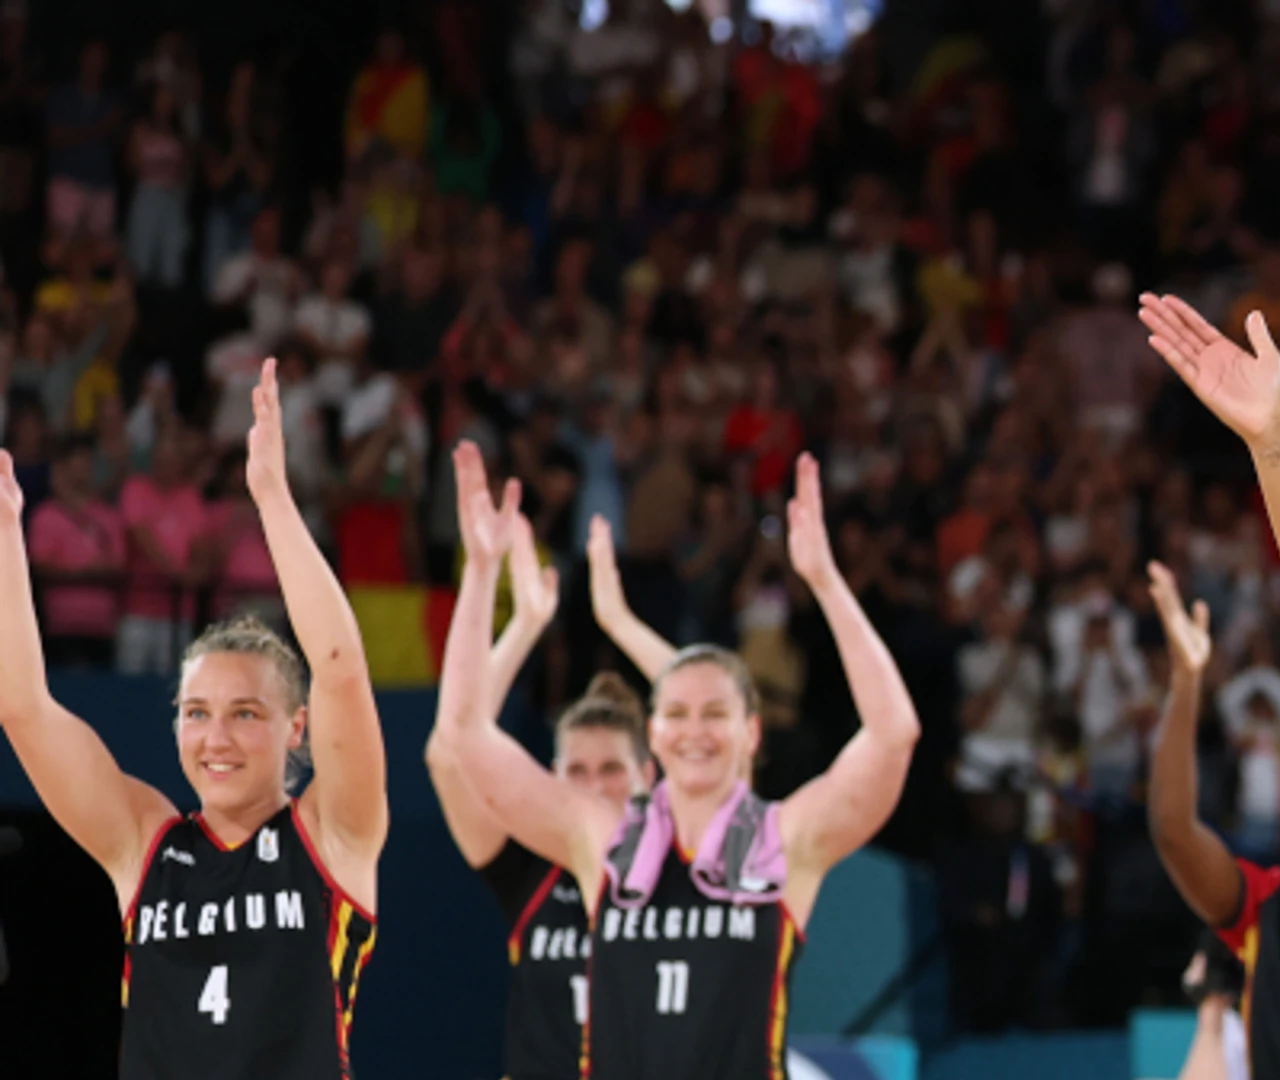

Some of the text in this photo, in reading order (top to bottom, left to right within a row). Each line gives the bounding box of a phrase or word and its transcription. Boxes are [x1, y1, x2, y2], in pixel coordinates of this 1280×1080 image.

[138, 889, 305, 945] BELGIUM
[602, 905, 756, 942] BELGIUM
[197, 964, 231, 1025] 4
[656, 960, 690, 1014] 11
